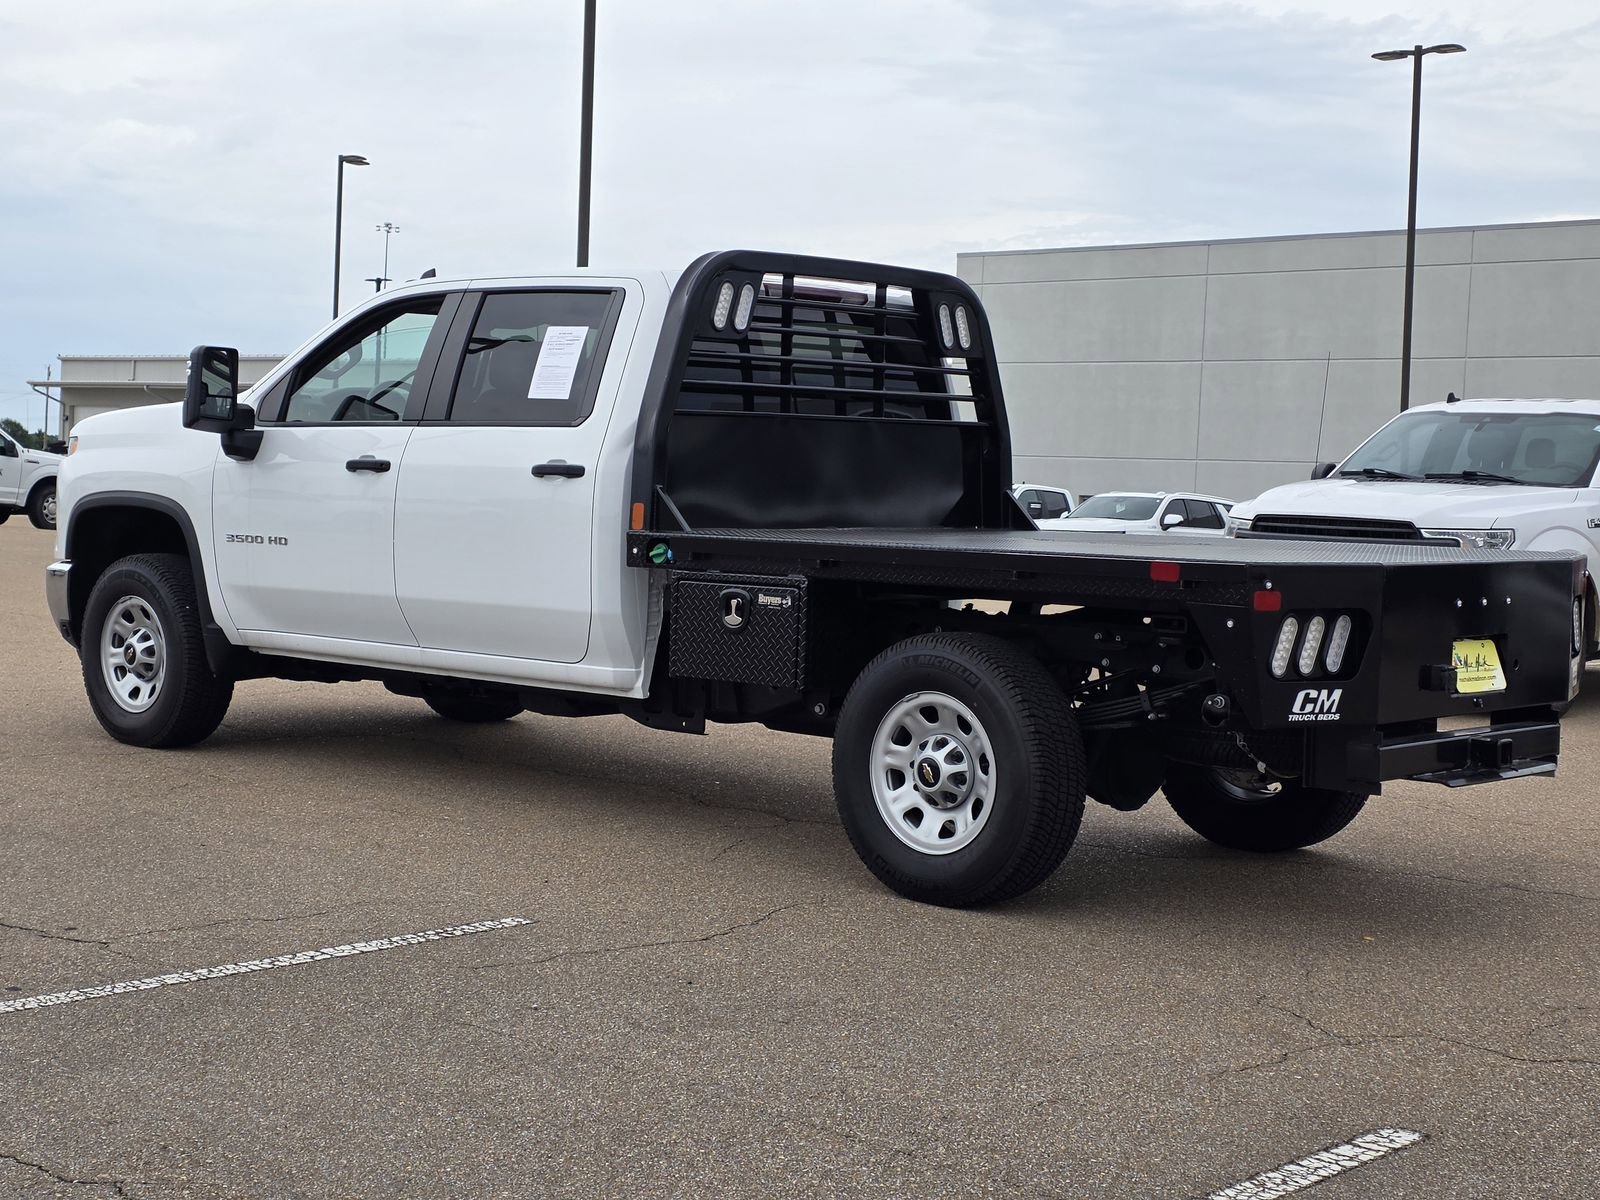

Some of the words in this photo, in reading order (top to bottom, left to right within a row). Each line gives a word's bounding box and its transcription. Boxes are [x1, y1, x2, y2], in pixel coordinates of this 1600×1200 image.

[225, 533, 264, 544] 3500
[268, 536, 288, 546] HD
[758, 593, 782, 605] Buyers
[1292, 688, 1343, 714] CM
[1288, 714, 1317, 722] TRUCK
[1316, 713, 1341, 721] BEDS
